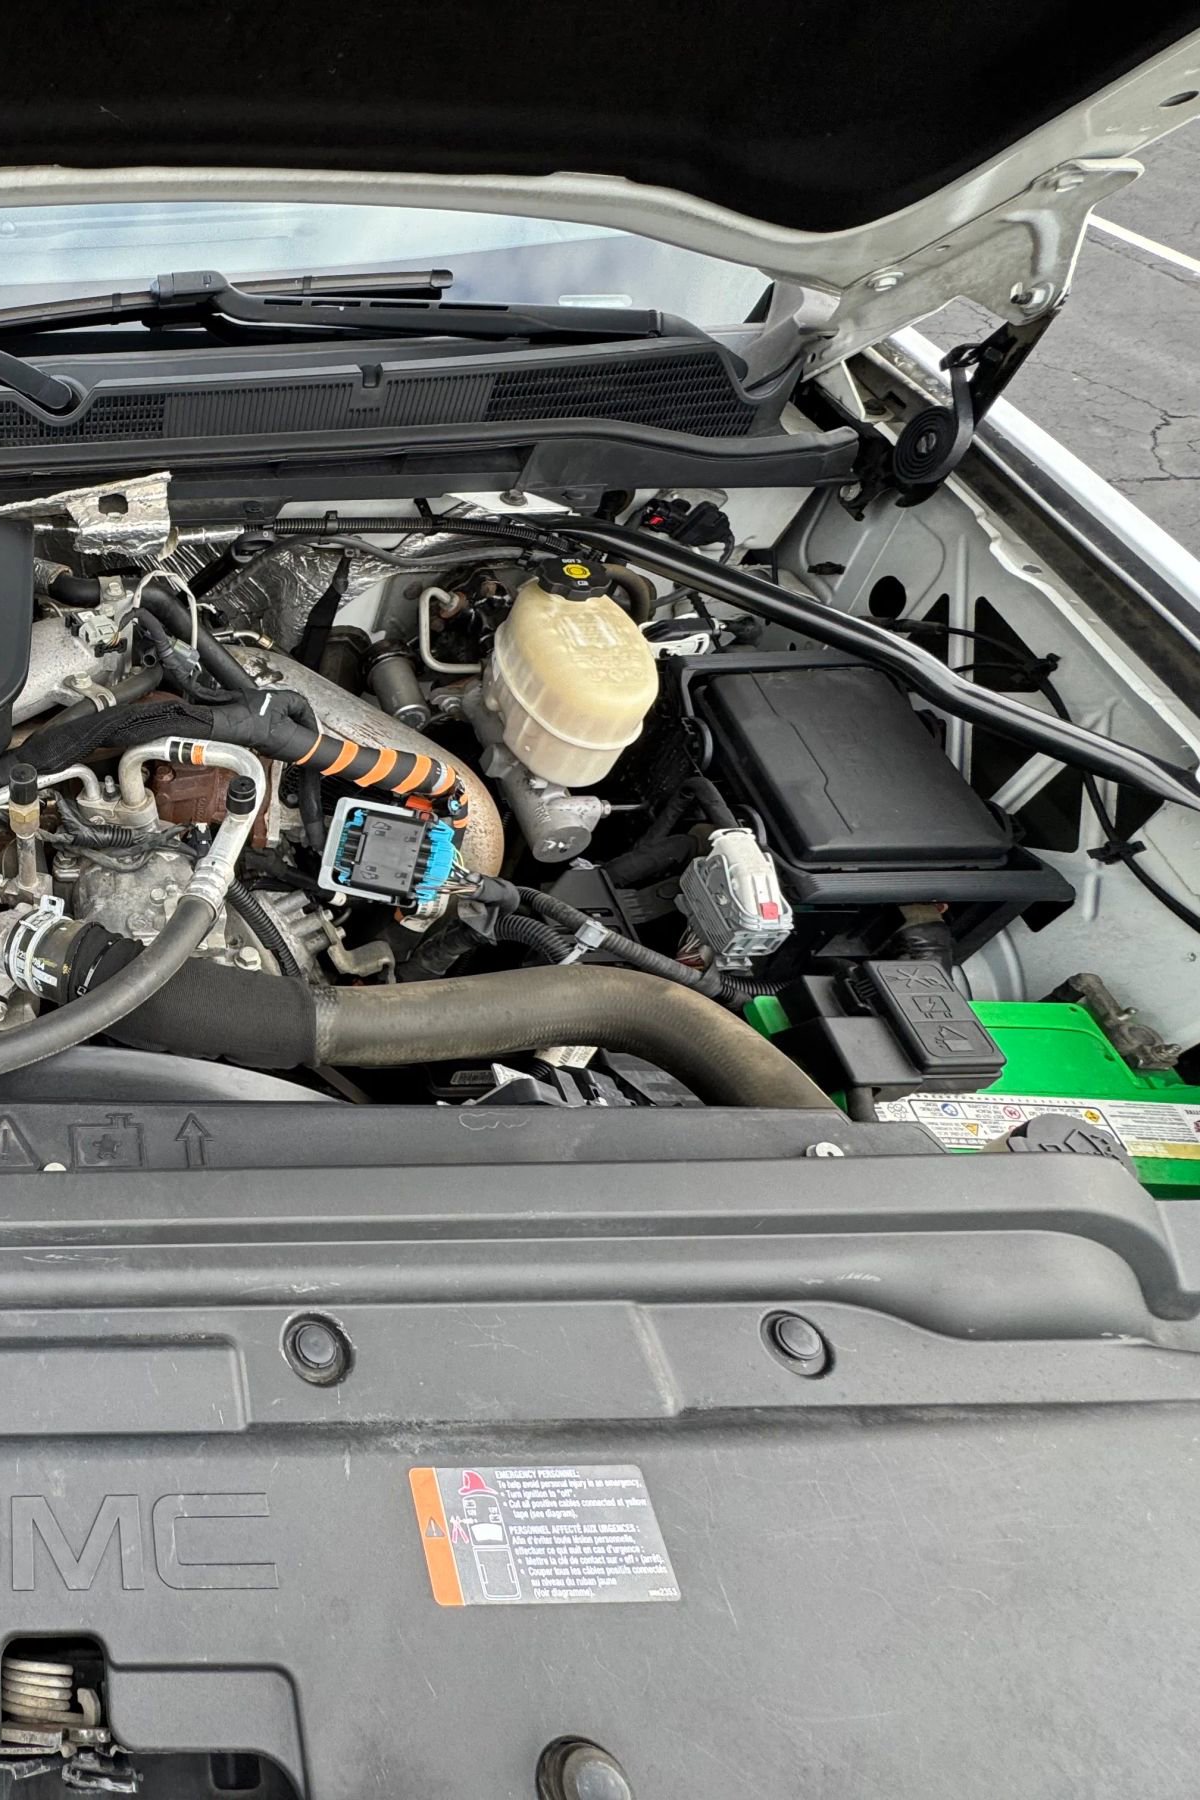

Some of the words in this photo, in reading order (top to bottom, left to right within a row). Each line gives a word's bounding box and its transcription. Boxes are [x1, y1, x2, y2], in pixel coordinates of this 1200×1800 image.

[494, 1470, 536, 1479] EMERGENCY
[537, 1470, 580, 1478] PERSONNEL:
[497, 1480, 506, 1488] To
[506, 1480, 521, 1489] help
[522, 1480, 540, 1488] avoid
[540, 1479, 567, 1489] personal
[568, 1479, 586, 1489] injury
[586, 1479, 595, 1487] in
[505, 1490, 522, 1498] Turn
[522, 1490, 548, 1499] ignition
[548, 1489, 556, 1497] to
[509, 1500, 521, 1508] Cut
[521, 1500, 530, 1508] all
[531, 1500, 557, 1509] positive
[559, 1499, 580, 1507] cables
[581, 1498, 616, 1507] connected
[616, 1498, 625, 1506] at
[624, 1498, 647, 1508] yellow
[513, 1509, 529, 1519] tape
[530, 1509, 544, 1519] (see
[509, 1526, 551, 1535] PERSONNEL
[552, 1524, 582, 1534] AFFECTÉ
[583, 1525, 598, 1533] AUX
[512, 1536, 526, 1544] Afin
[553, 1536, 571, 1544] toute
[515, 1547, 545, 1555] effectuer
[556, 1546, 568, 1557] qui
[525, 1557, 549, 1565] Mettre
[549, 1556, 557, 1565] la
[569, 1556, 579, 1564] de
[580, 1556, 606, 1564] contact
[528, 1567, 552, 1577] Couper
[554, 1567, 570, 1575] tous
[570, 1566, 581, 1575] les
[632, 1564, 668, 1574] connectés
[540, 1577, 565, 1586] niveau
[565, 1577, 575, 1585] du
[576, 1576, 597, 1585] ruban
[597, 1576, 617, 1588] jaune
